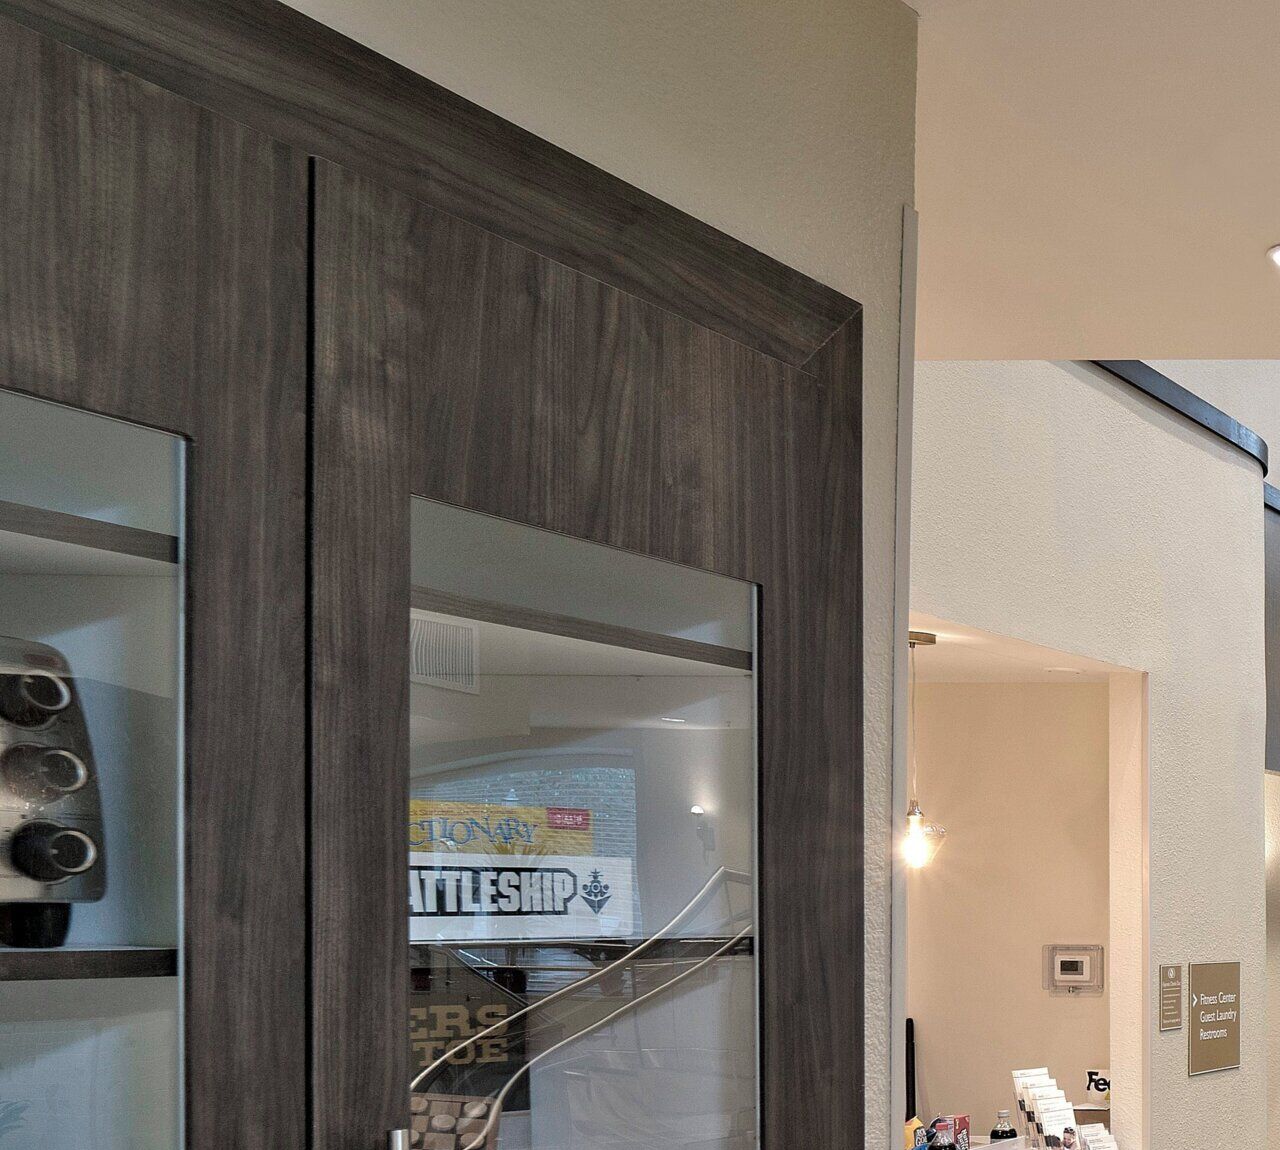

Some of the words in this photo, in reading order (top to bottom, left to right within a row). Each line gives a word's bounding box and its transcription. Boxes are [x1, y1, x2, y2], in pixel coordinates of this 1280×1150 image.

[409, 871, 574, 914] ATTLESHIP
[1200, 993, 1218, 1006] Fitness
[1218, 992, 1237, 1004] Center
[1200, 1011, 1216, 1023] Guest
[1216, 1008, 1237, 1022] Laundry
[1200, 1029, 1228, 1041] Restrooms
[412, 1038, 509, 1067] TOE
[1086, 1071, 1111, 1093] Fe
